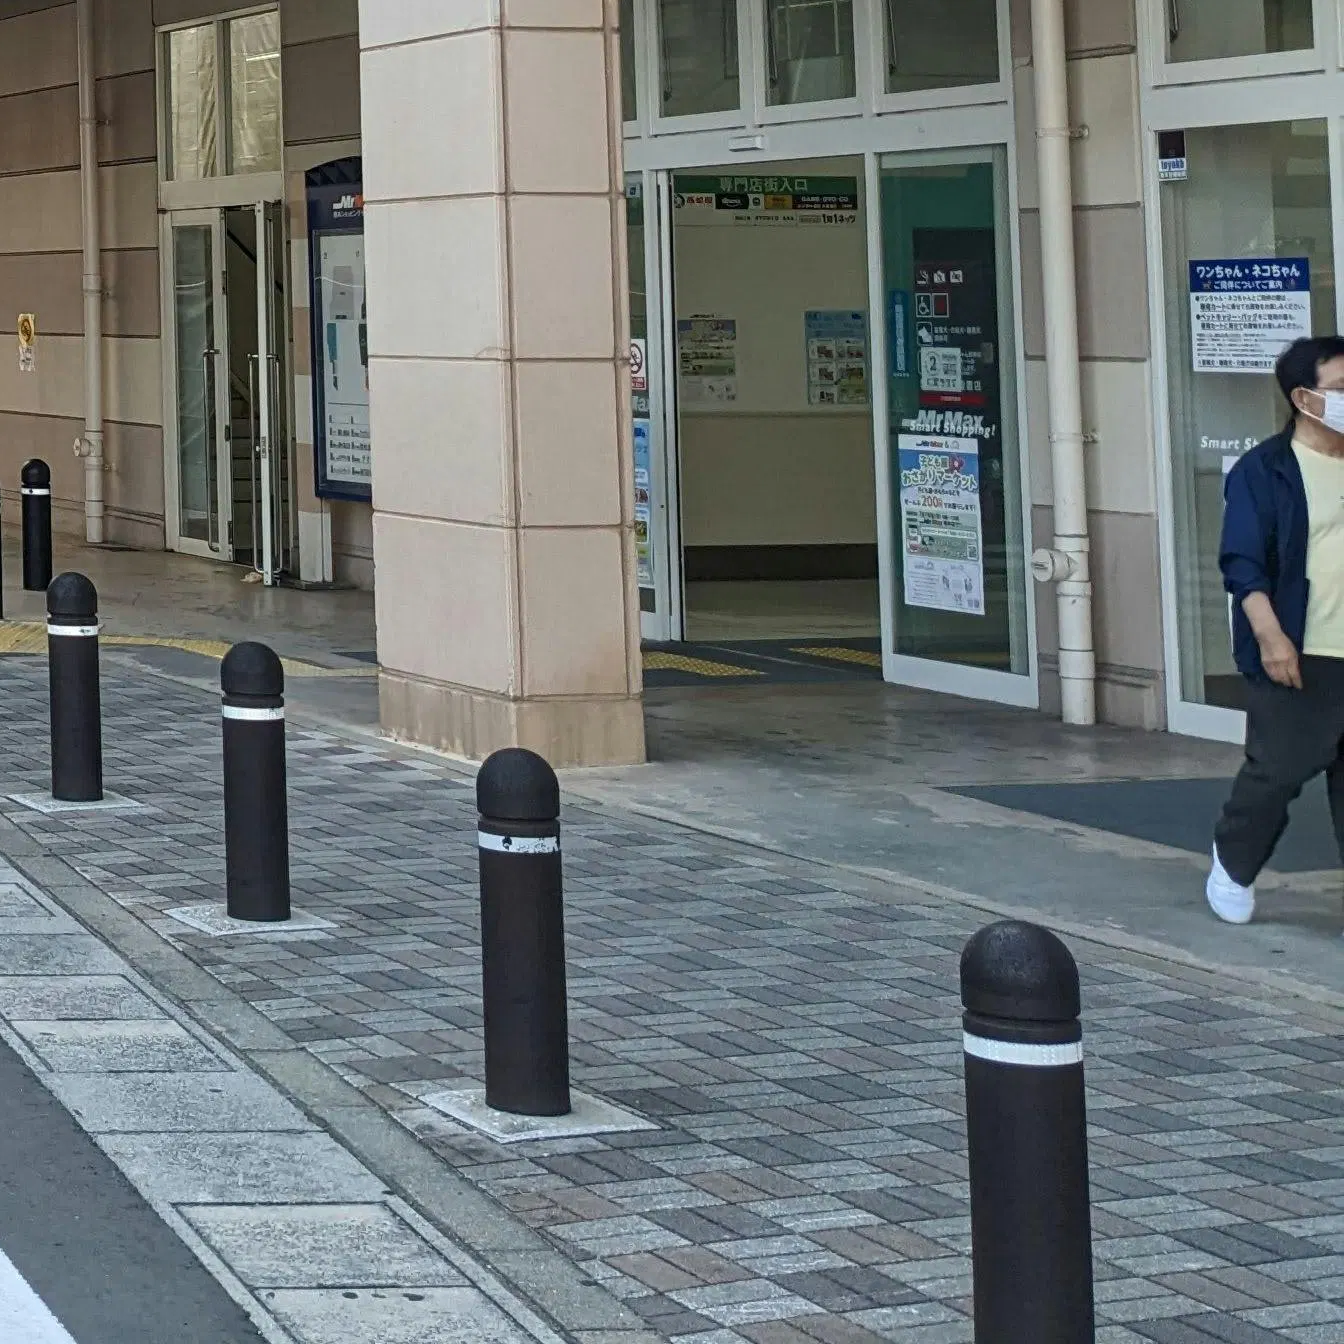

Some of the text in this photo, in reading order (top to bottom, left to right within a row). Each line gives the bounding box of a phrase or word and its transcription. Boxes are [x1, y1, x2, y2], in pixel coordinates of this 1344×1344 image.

[1196, 263, 1300, 278] ワンちゃん・ネコちゃん
[1201, 436, 1240, 450] Smart
